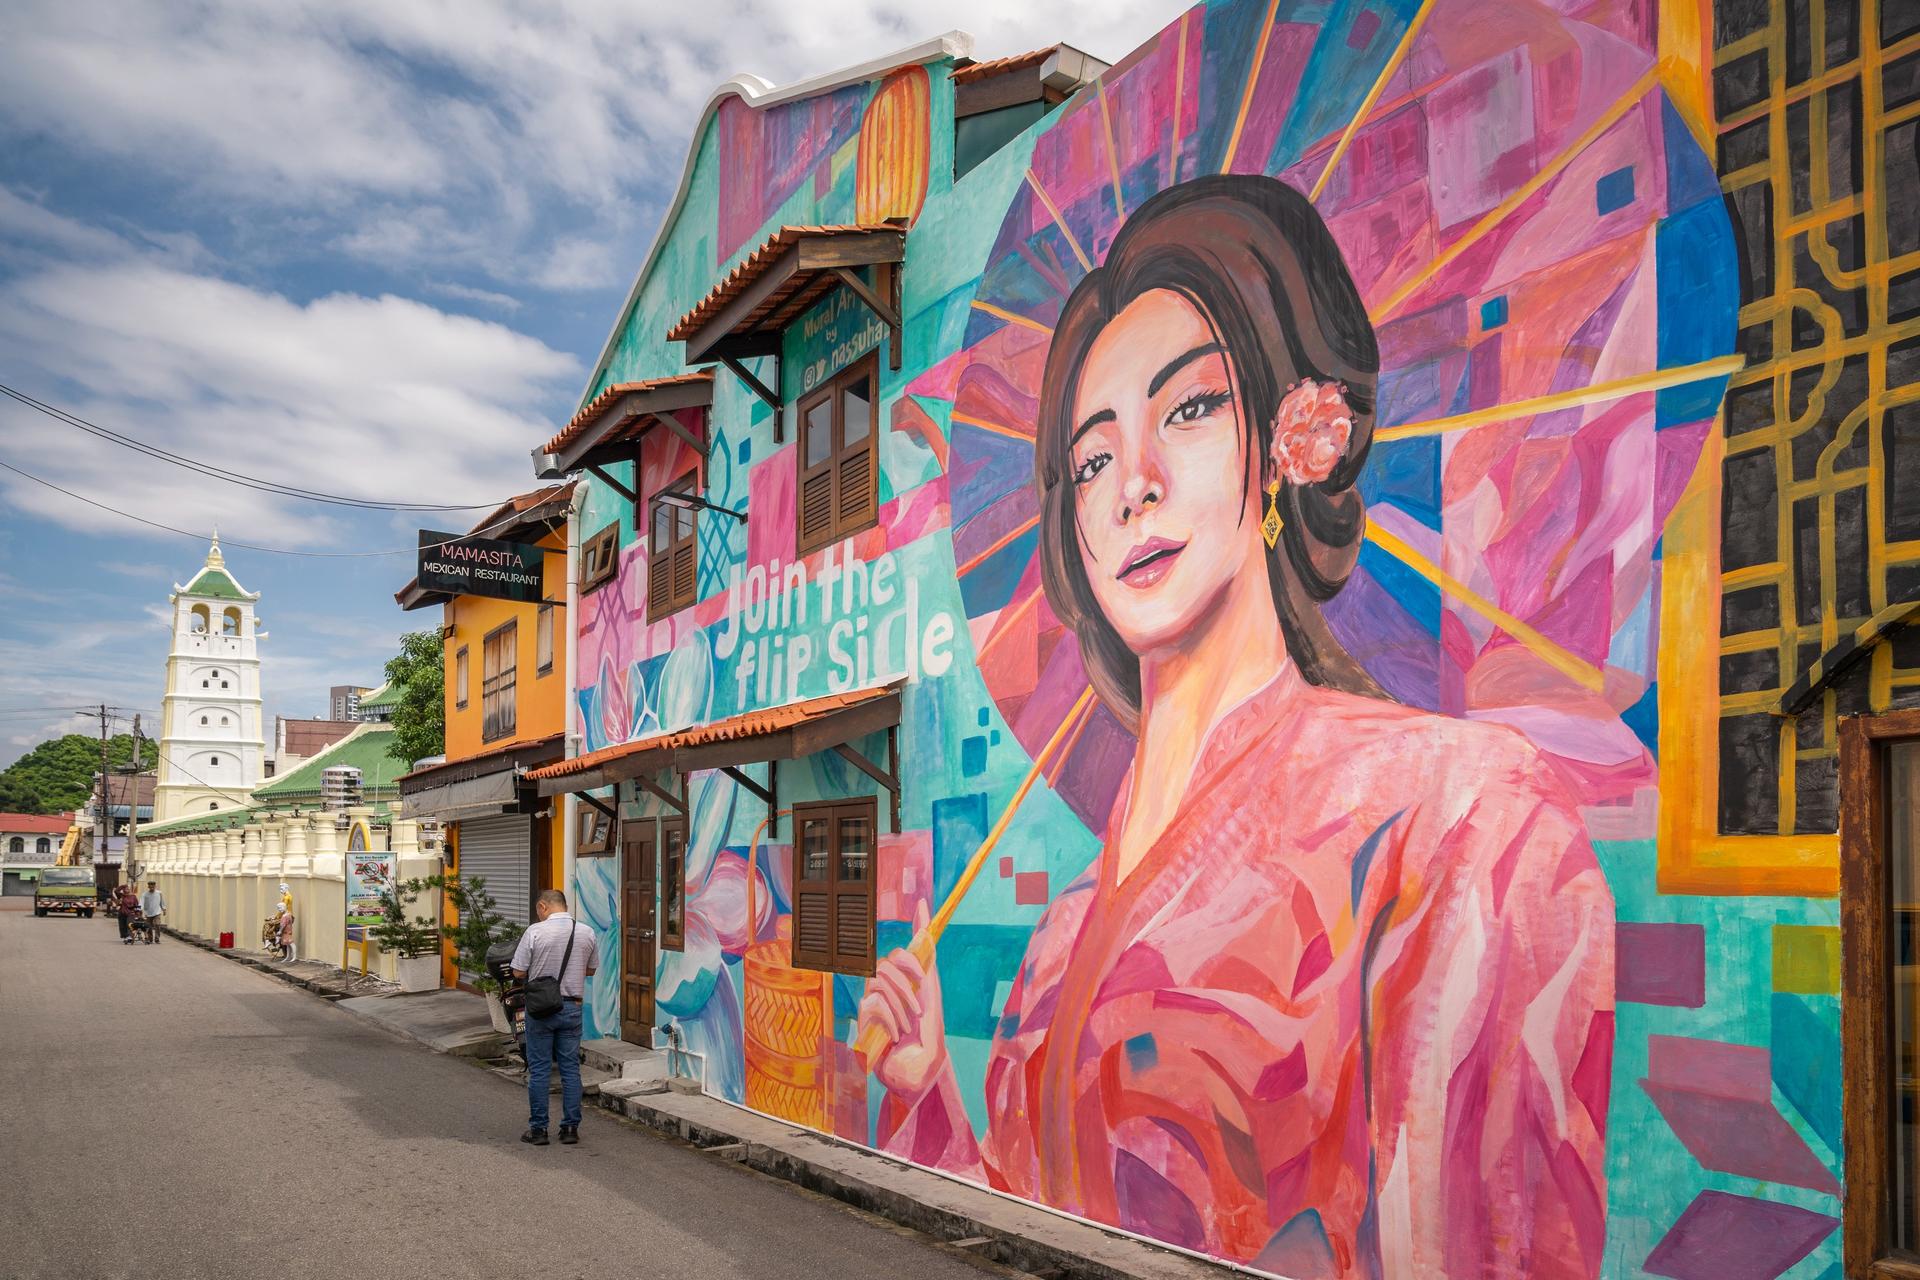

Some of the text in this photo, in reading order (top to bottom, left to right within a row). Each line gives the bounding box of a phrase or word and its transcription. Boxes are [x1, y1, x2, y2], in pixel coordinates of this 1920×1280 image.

[804, 296, 834, 342] Mural
[826, 326, 837, 343] by
[423, 561, 539, 586] MEXICAN RESTAURANT
[441, 544, 524, 568] MAMASITA
[816, 536, 897, 624] the
[735, 576, 954, 711] flip Side
